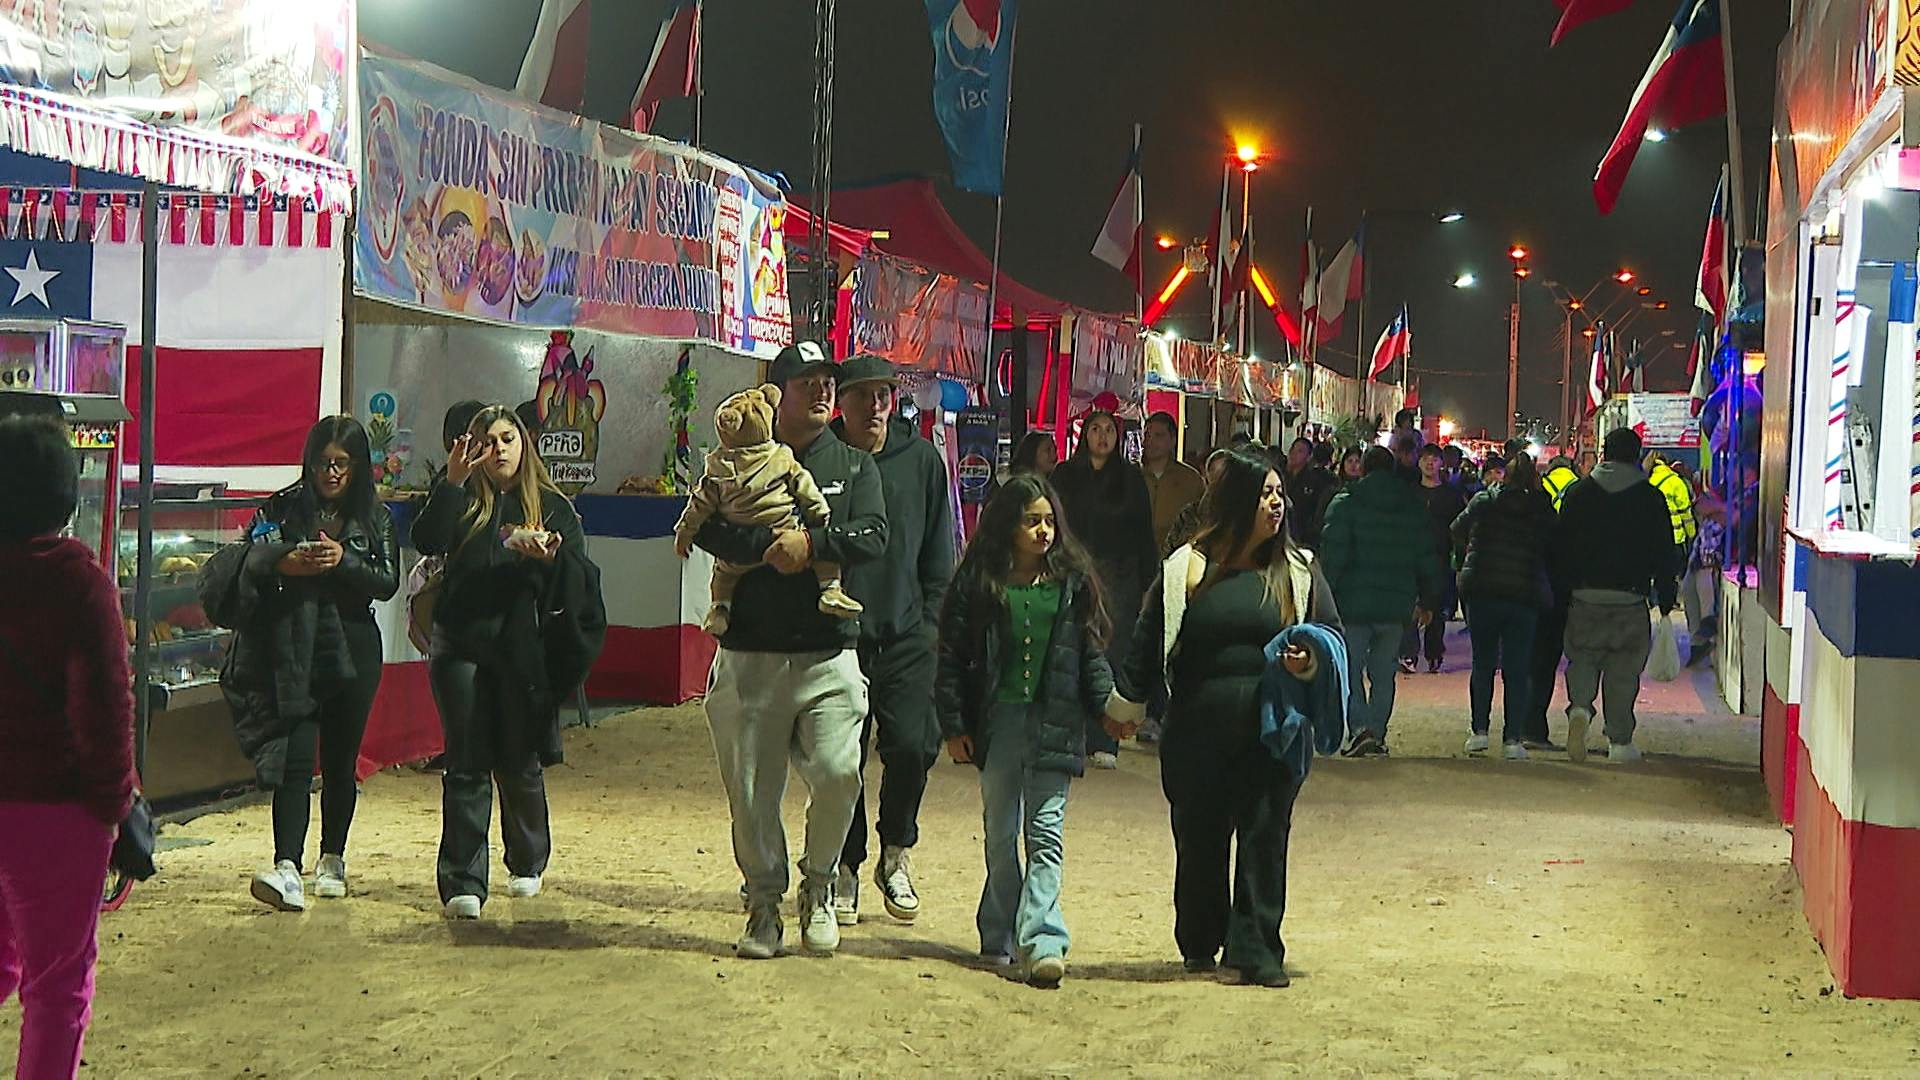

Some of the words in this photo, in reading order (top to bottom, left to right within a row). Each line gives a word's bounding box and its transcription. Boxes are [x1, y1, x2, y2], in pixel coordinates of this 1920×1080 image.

[497, 129, 529, 207] SIN
[605, 256, 627, 306] SIN
[627, 259, 682, 309] TERCERA
[540, 433, 581, 454] Piña
